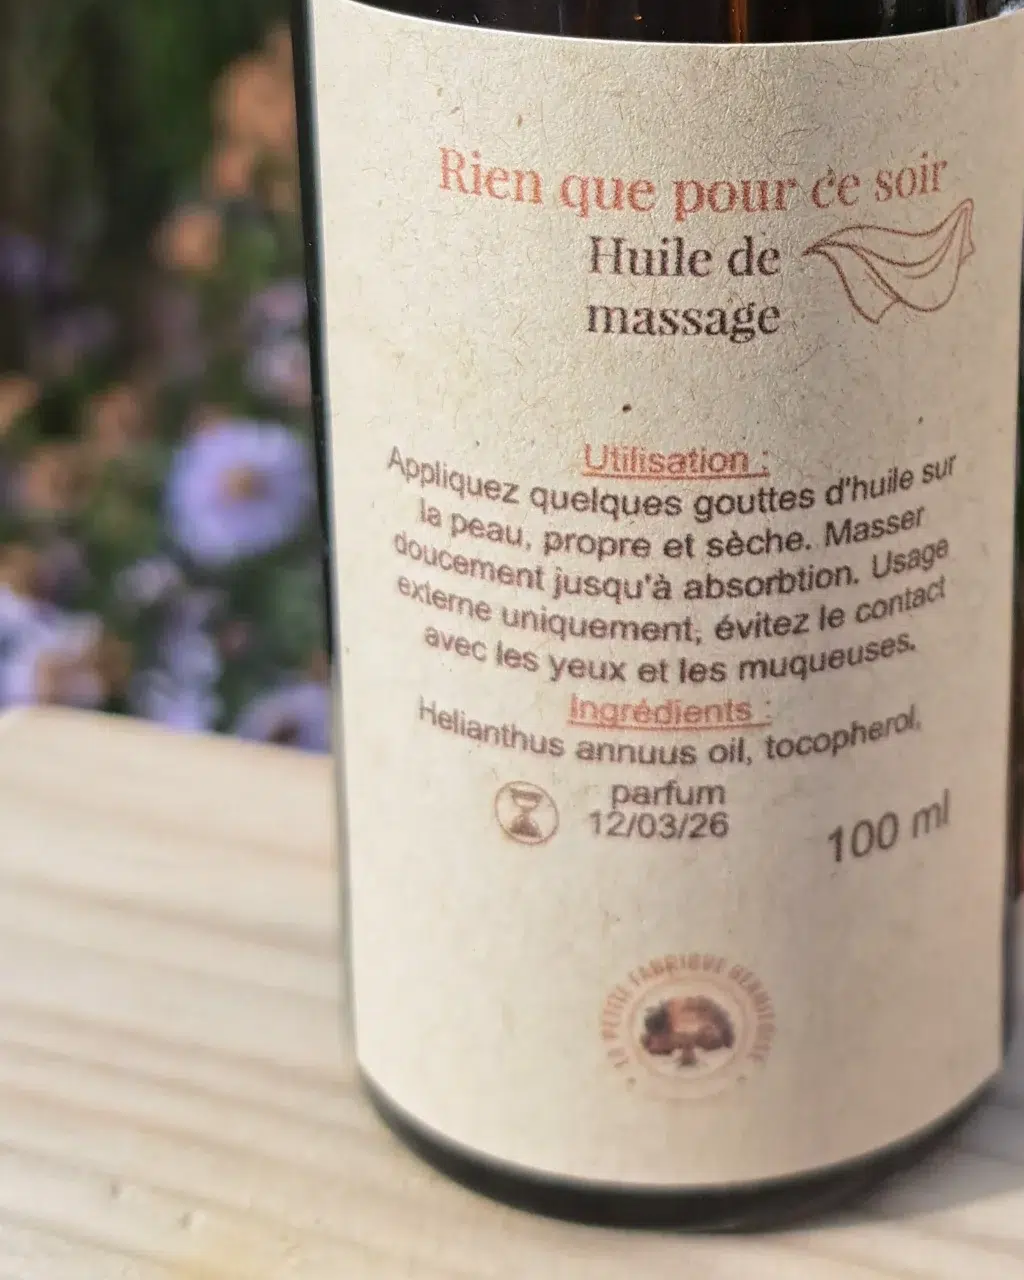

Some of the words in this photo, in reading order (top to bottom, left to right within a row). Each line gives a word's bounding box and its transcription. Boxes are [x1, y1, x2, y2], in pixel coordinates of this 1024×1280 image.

[439, 147, 543, 204] Rien
[560, 173, 655, 220] que
[671, 178, 797, 223] pour
[811, 170, 860, 209] ce
[875, 151, 948, 203] soir
[589, 235, 712, 277] Huile
[727, 235, 780, 276] de
[587, 301, 781, 344] massage
[387, 445, 520, 505] Appliquez
[529, 486, 682, 521] quelques
[694, 487, 816, 523] gouttes
[825, 466, 914, 506] d'huile
[921, 454, 957, 485] sur
[583, 444, 749, 478] Utilisation
[420, 497, 442, 527] la
[450, 511, 532, 552] peau,
[543, 530, 651, 561] propre
[663, 533, 695, 559] et
[706, 530, 812, 559] sèche.
[824, 506, 925, 548] Masser
[394, 531, 545, 591] doucement
[552, 567, 672, 604] jusqu'à
[684, 564, 859, 600] absorbtion.
[871, 538, 949, 580] Usage
[397, 575, 493, 621] externe
[715, 611, 810, 641] évitez
[819, 604, 845, 632] le
[854, 575, 946, 624] contact
[424, 626, 488, 662] avec
[496, 640, 540, 672] les
[548, 655, 627, 683] yeux
[637, 656, 669, 683] et
[679, 657, 727, 684] les
[739, 632, 916, 680] muqueuses.
[418, 695, 565, 757] Helianthus
[575, 740, 697, 765] annuus
[708, 736, 753, 766] oil,
[570, 693, 753, 726] Ingrédients
[588, 809, 730, 840] 12/03/26
[611, 779, 726, 809] parfum
[828, 811, 899, 862] 100
[912, 787, 950, 839] ml
